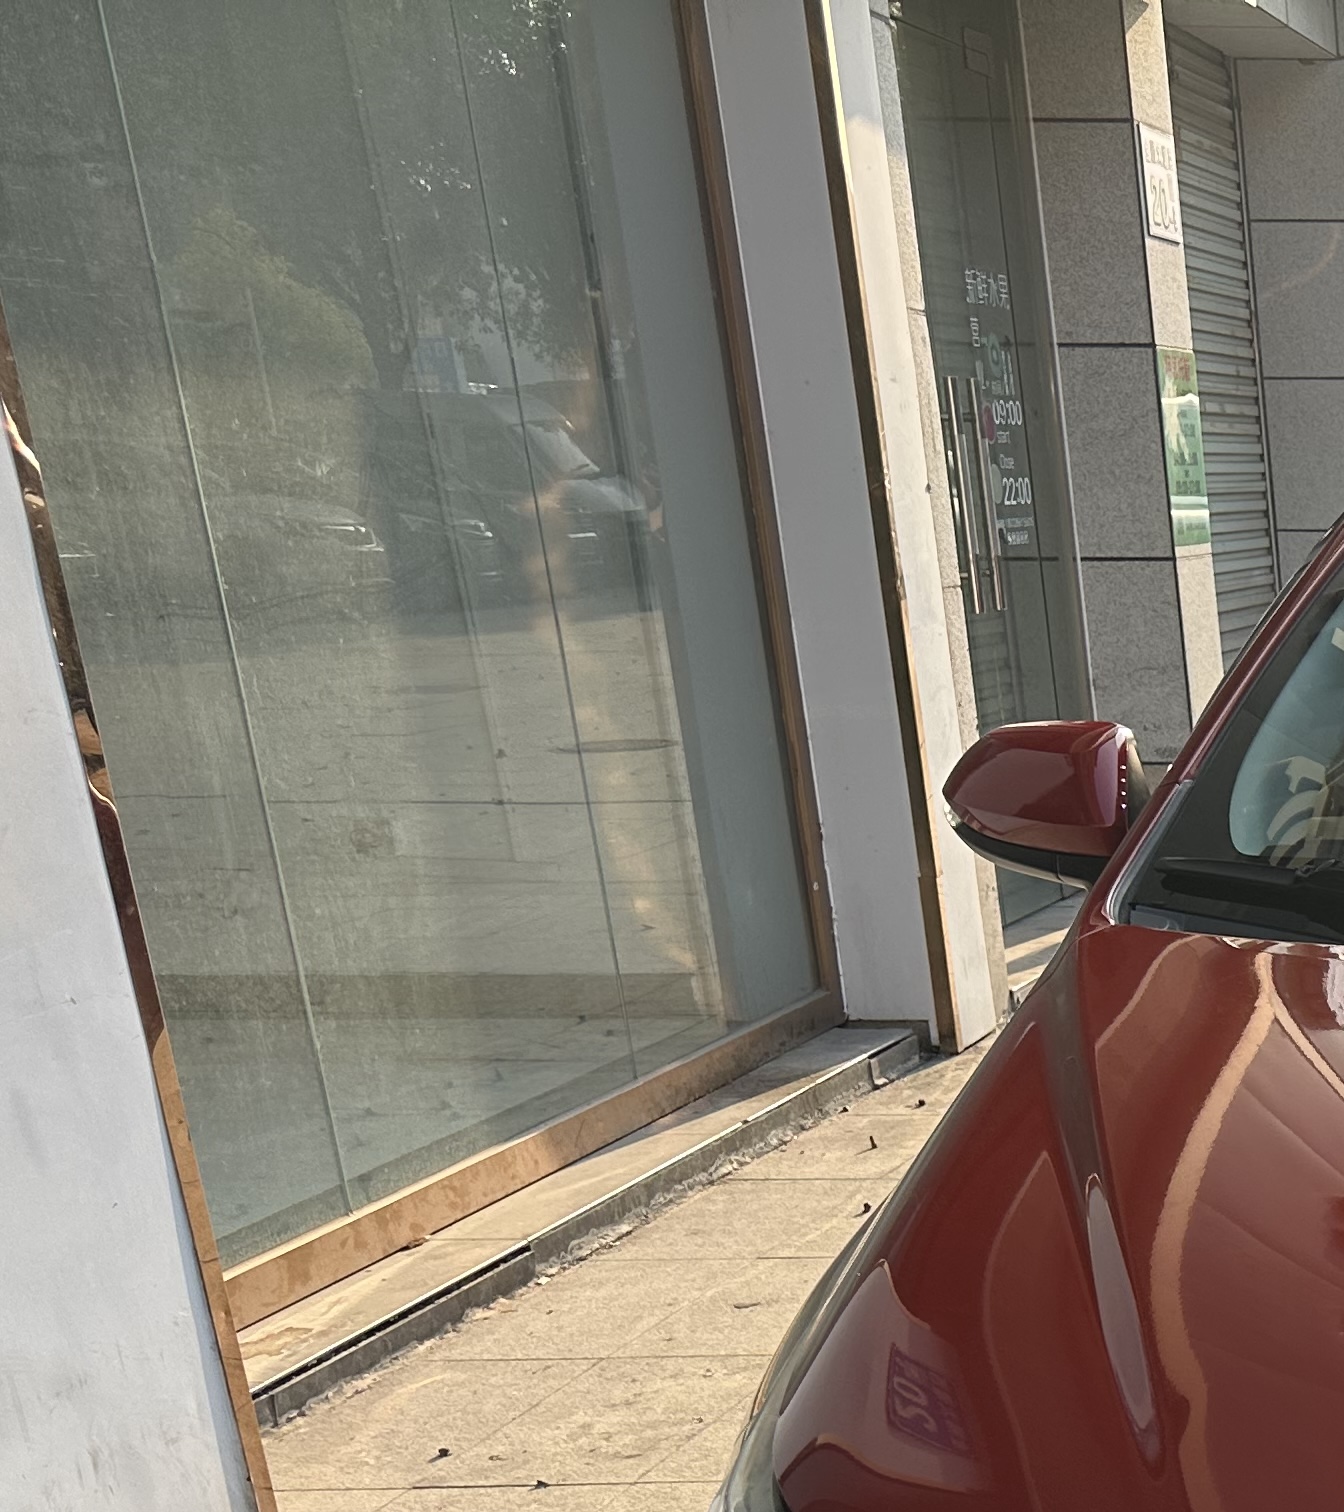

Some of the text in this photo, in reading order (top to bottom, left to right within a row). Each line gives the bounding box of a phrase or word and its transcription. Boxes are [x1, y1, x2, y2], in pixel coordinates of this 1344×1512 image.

[965, 267, 1009, 310] 新鲜水果
[993, 400, 1022, 426] 09:00
[1002, 477, 1032, 506] 22:00
